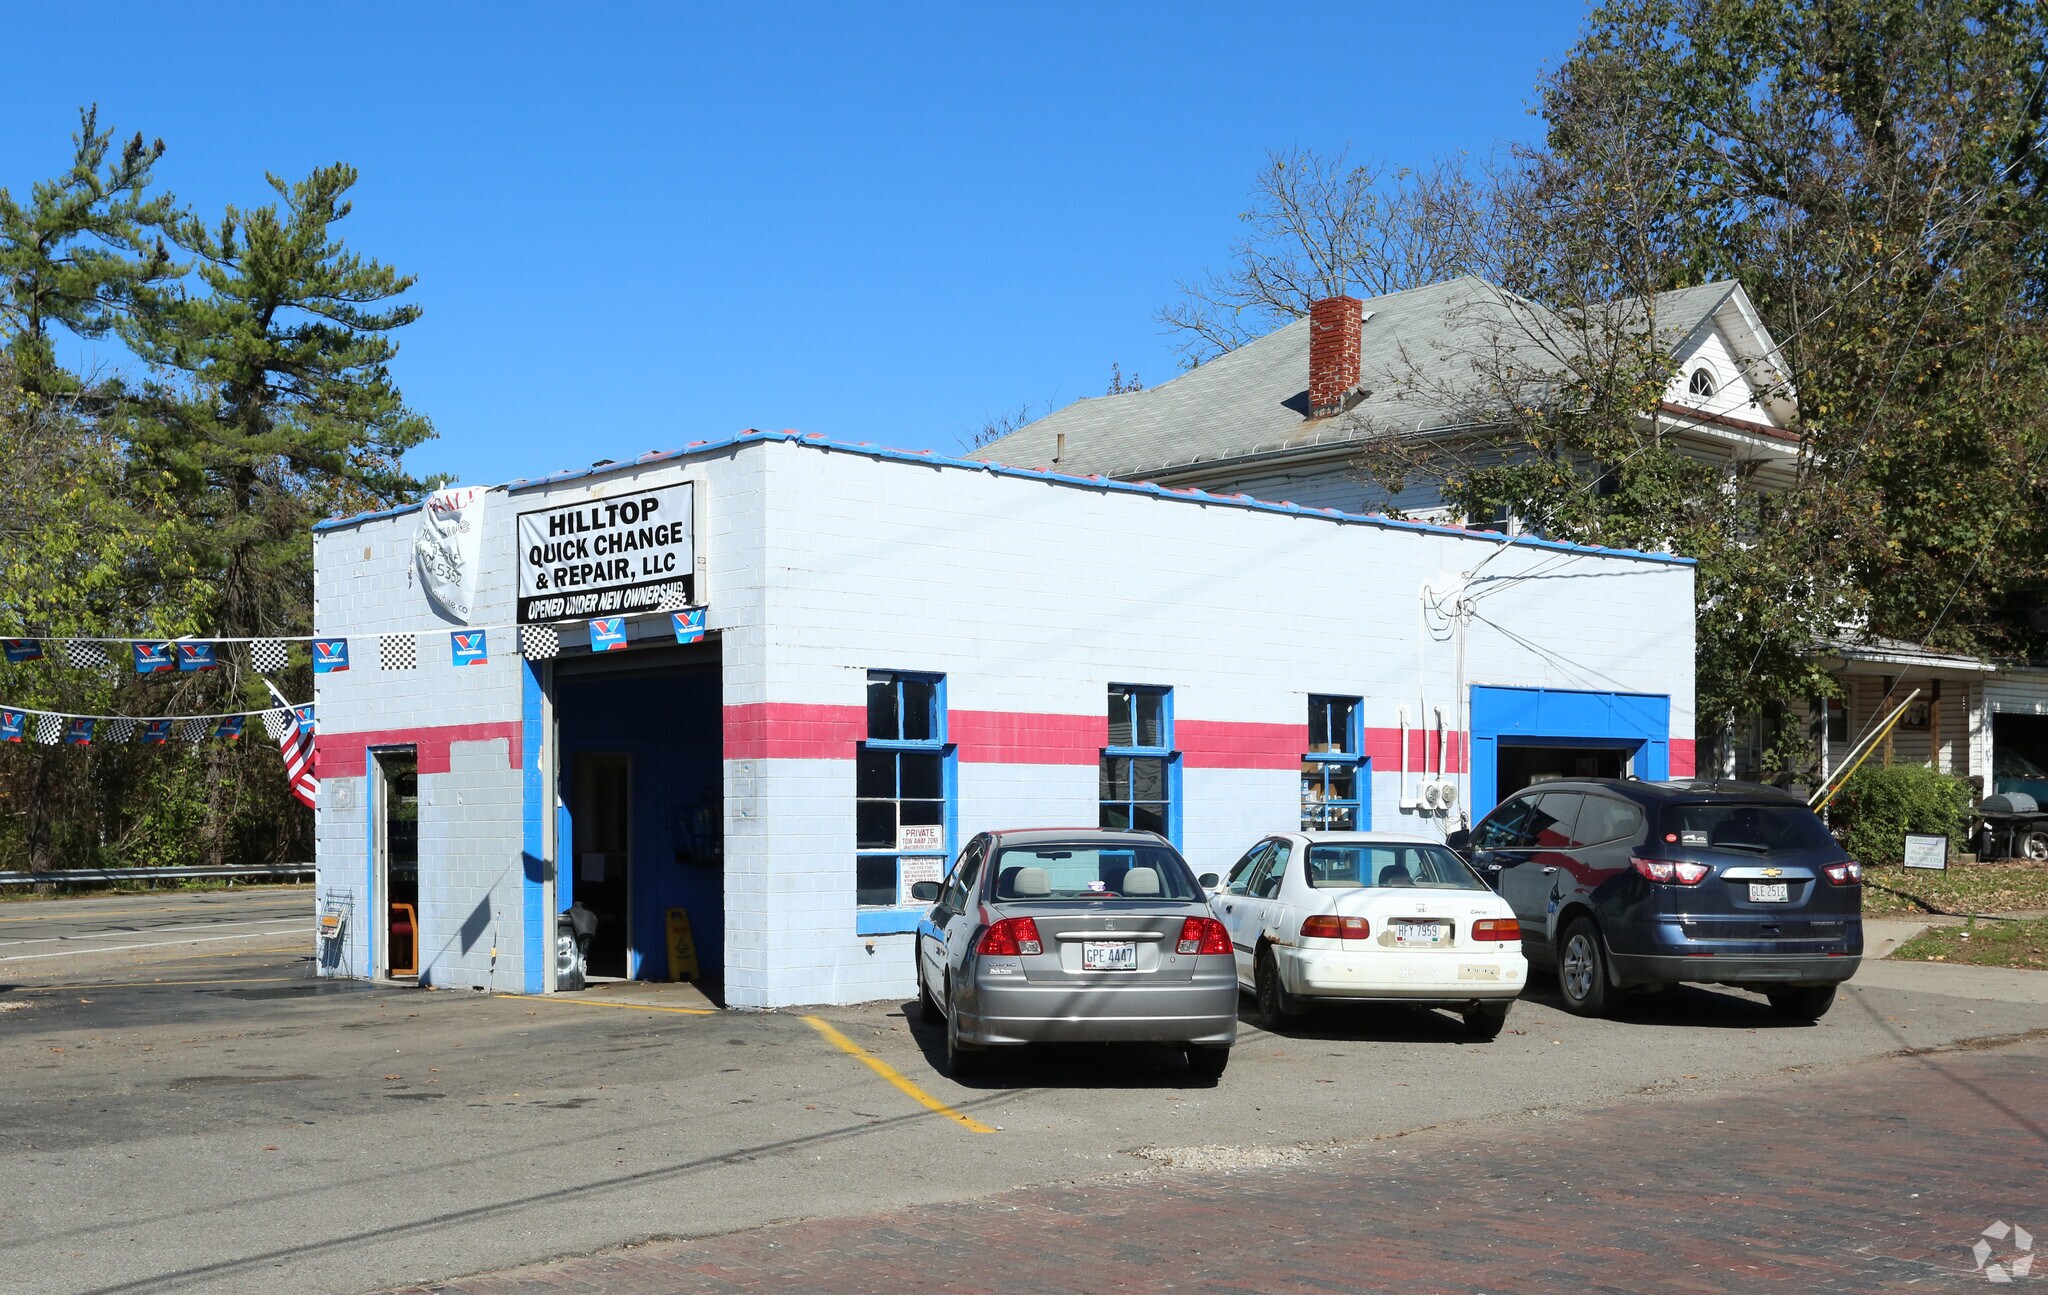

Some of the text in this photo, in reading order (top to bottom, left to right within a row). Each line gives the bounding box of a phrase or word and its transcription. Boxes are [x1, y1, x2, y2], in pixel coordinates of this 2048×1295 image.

[549, 498, 659, 537] HILLTOP
[529, 521, 683, 568] QUICK CHANGE
[535, 552, 676, 590] & REPAIR, LLC
[528, 581, 684, 620] OPENED UNDER NEW OWNERSHIP
[678, 625, 703, 634] Valvoline
[595, 633, 623, 641] Valvoline
[905, 828, 935, 838] PRIVATE
[1751, 885, 1786, 897] GLE 2512
[1398, 925, 1438, 937] HFY 7959
[1086, 948, 1133, 963] GPE 4447
